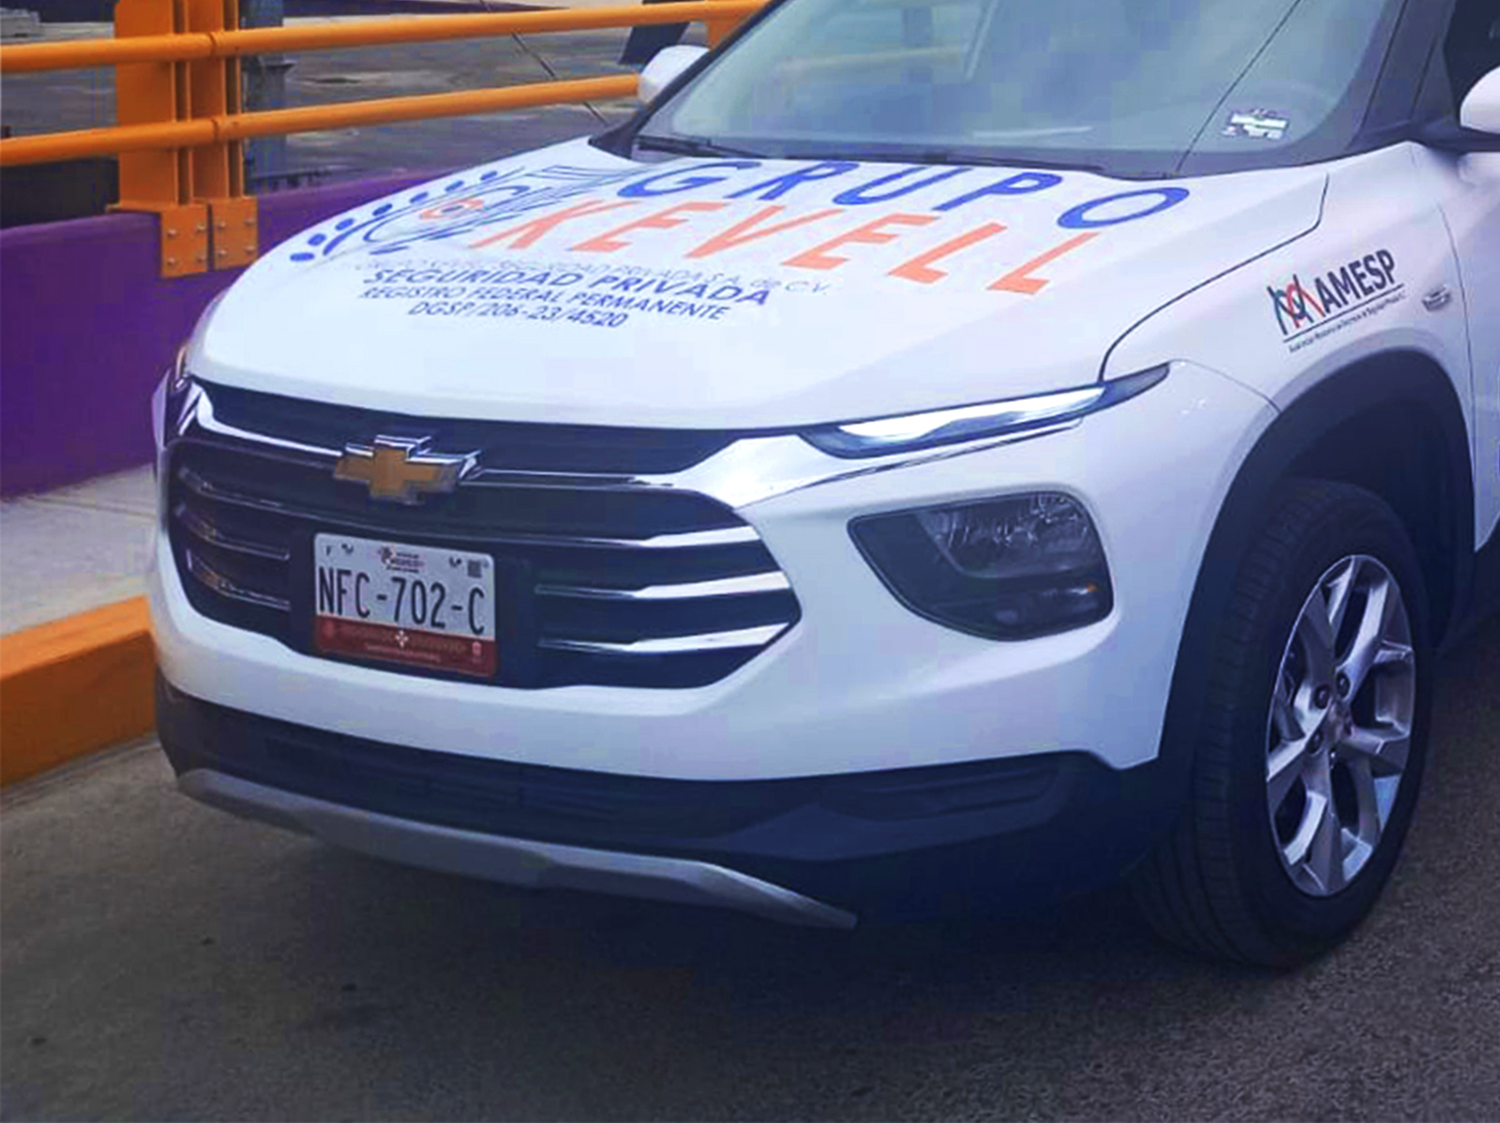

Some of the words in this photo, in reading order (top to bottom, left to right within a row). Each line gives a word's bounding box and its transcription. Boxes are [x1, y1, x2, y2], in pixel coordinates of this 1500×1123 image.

[617, 161, 1190, 228] GRUPO
[468, 200, 1101, 294] KEVELL
[358, 285, 467, 299] REGISTRO
[467, 286, 567, 304] FEDERAL
[566, 291, 732, 321] PERMANENTE
[363, 268, 584, 287] SEGURIDAD
[587, 275, 770, 306] PRIVADA
[1314, 248, 1395, 314] AMESP
[319, 566, 485, 636] NFC-702-C
